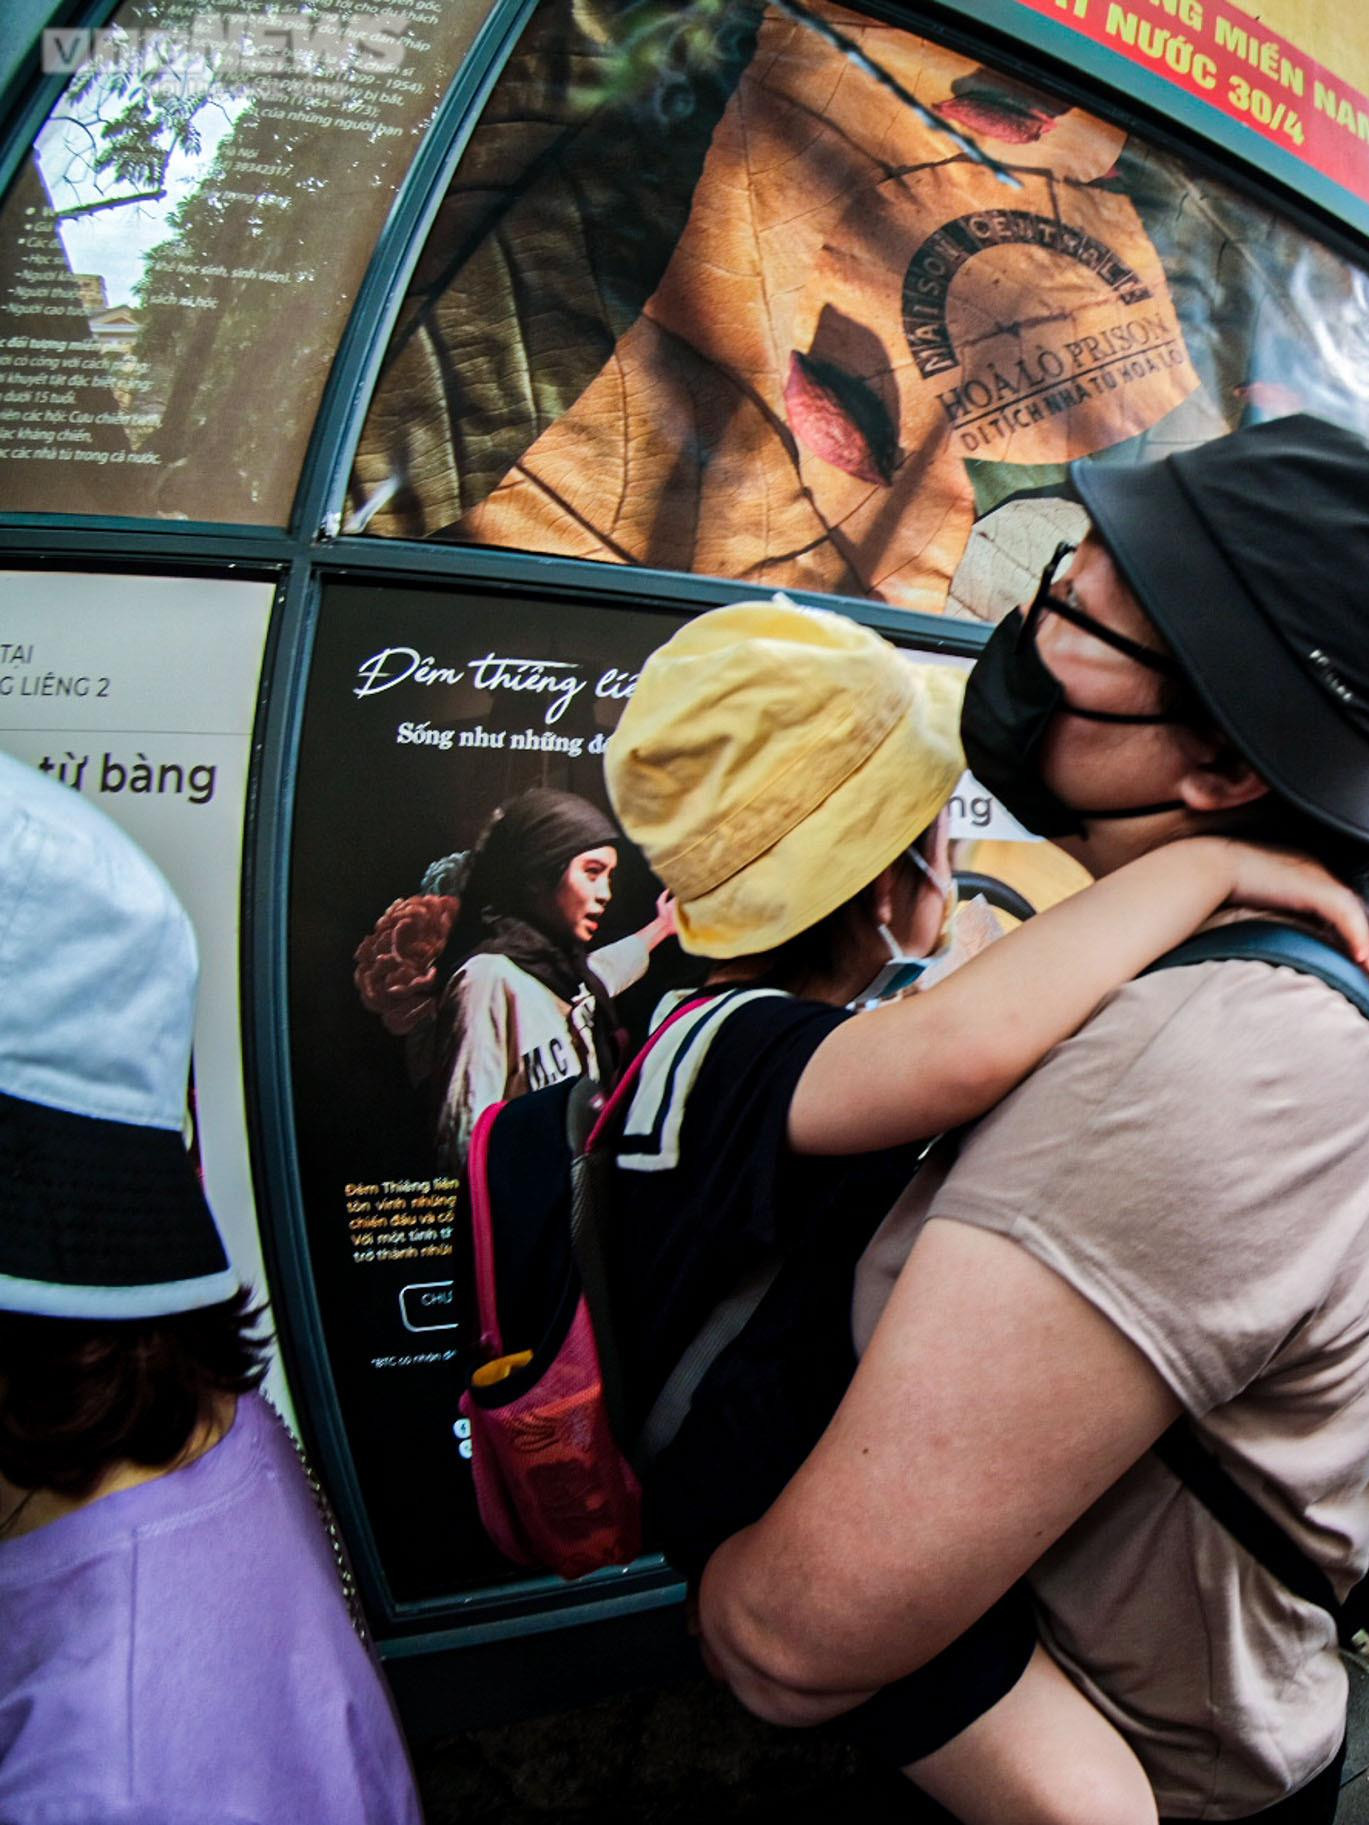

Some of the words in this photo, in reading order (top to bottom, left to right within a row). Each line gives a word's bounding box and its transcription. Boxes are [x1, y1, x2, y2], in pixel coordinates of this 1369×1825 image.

[1105, 3, 1217, 90] NƯỚC
[1228, 75, 1305, 146] 30/4
[1065, 312, 1171, 370] PRISON
[95, 677, 111, 698] 2
[352, 646, 465, 699] Đêm
[396, 720, 456, 751] Sống
[459, 726, 508, 749] như
[509, 728, 585, 758] những
[98, 752, 217, 805] bàng
